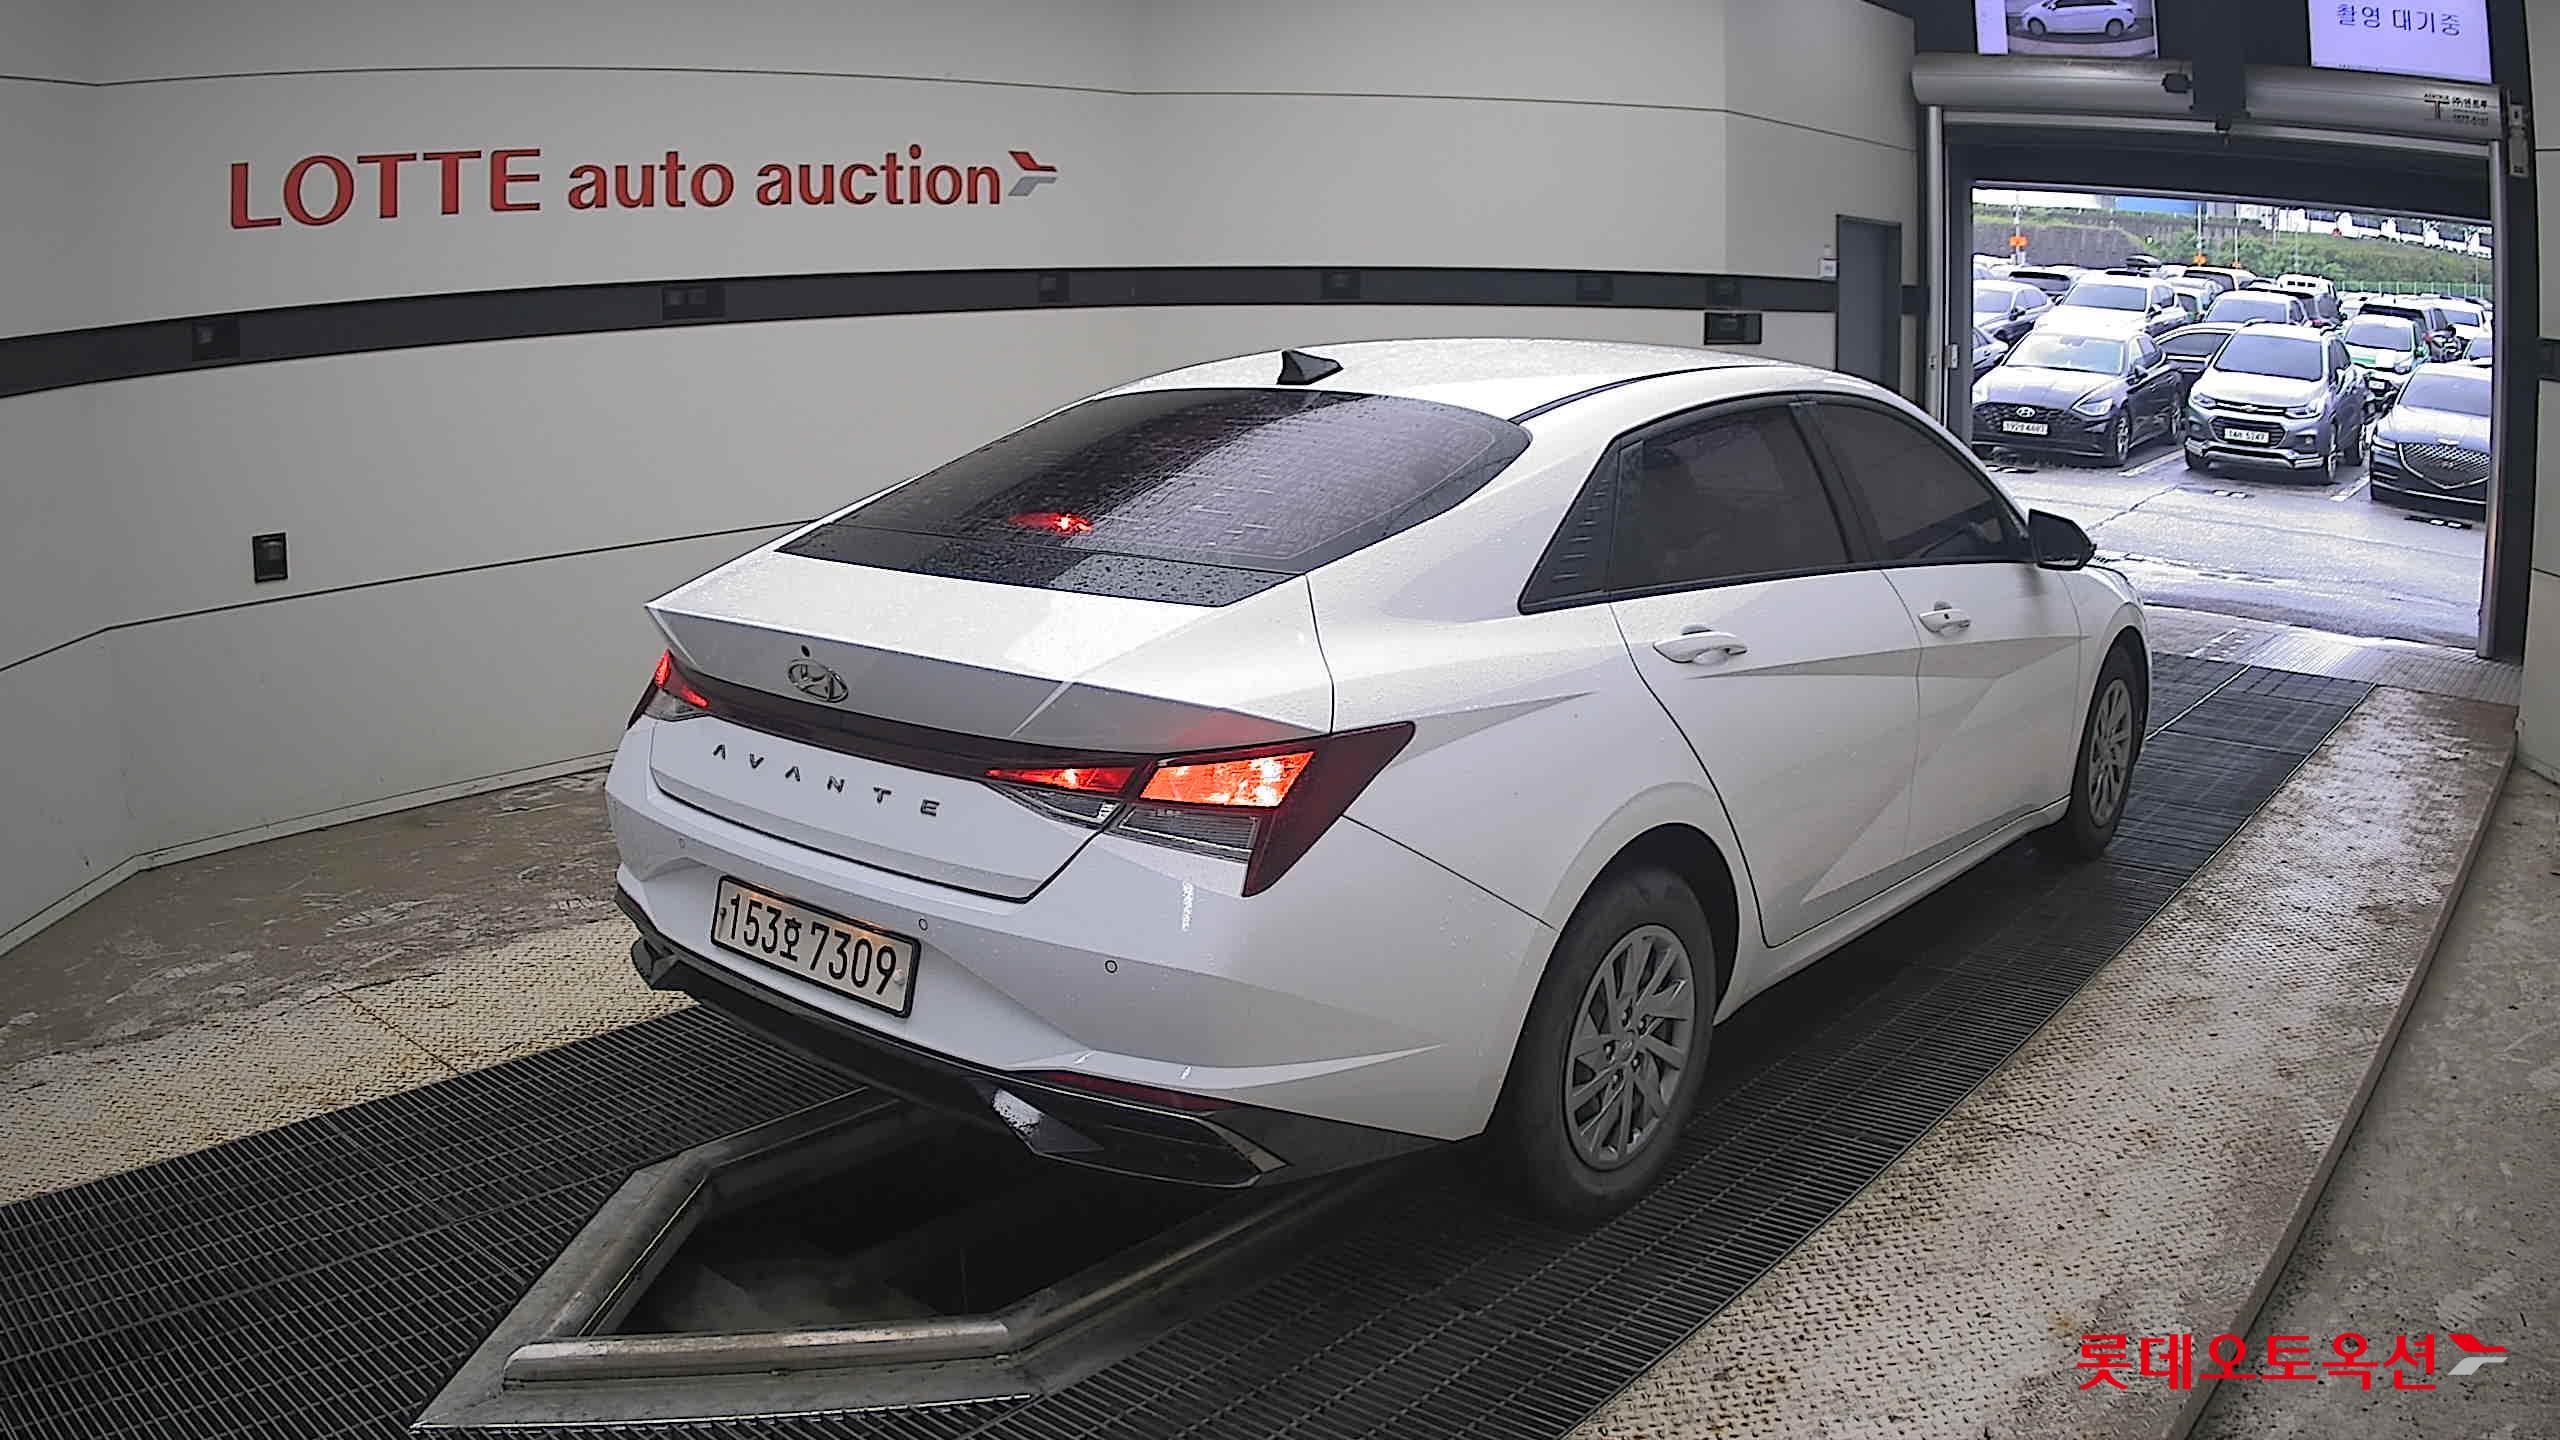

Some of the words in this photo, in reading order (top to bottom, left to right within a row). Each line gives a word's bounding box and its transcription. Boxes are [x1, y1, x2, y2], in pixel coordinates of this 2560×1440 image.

[2337, 3, 2382, 29] 촬영
[2391, 9, 2461, 37] 대기중
[229, 147, 542, 229] LOTTE
[567, 149, 736, 209] auto
[755, 143, 1002, 206] auction
[712, 743, 940, 817] AVANTE
[729, 893, 802, 962] 153호
[809, 920, 897, 996] 7309
